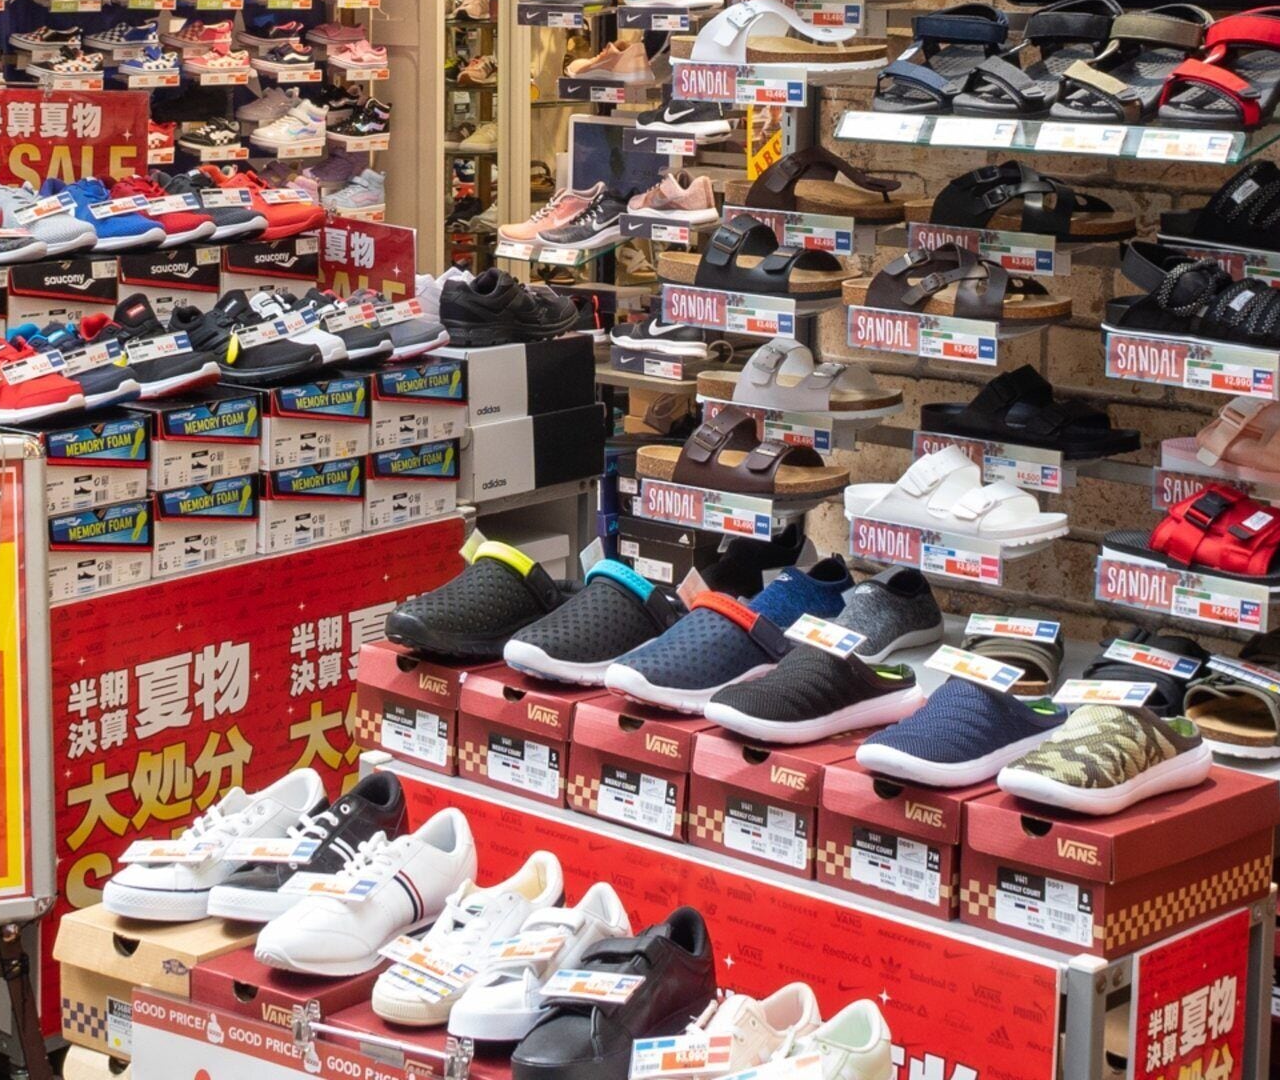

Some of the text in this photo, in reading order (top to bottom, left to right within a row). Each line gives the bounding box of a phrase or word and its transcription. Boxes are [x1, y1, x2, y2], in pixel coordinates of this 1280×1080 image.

[681, 68, 731, 97] SANDAL
[151, 261, 191, 275] saucony
[254, 252, 290, 265] saucony
[43, 273, 85, 288] saucony
[671, 292, 720, 323] SANDAL
[857, 315, 912, 348] SANDAL
[1117, 343, 1180, 378] SANDAL
[396, 373, 450, 393] MEMORY FOAM
[296, 390, 353, 410] MEMORY FOAM
[476, 404, 501, 416] adidas
[184, 413, 245, 435] MEMORY FOAM
[65, 433, 132, 458] MEMORY FOAM
[482, 478, 508, 490] adidas
[648, 488, 697, 520] SANDAL
[858, 524, 913, 560] SANDAL
[1107, 566, 1169, 606] SANDAL
[290, 614, 343, 659] 半期
[289, 652, 344, 698] 決算
[419, 672, 449, 696] VANS
[67, 670, 129, 718] 半期
[134, 640, 252, 740] 夏物
[527, 702, 560, 728] VANS
[67, 709, 129, 761] 決算
[644, 733, 680, 758] VANS
[65, 725, 254, 853] 大処分
[770, 764, 808, 790] VANS
[904, 800, 944, 828] VANS
[1056, 837, 1099, 866] VANS
[1000, 881, 1042, 898] WEEKLY COURT
[133, 999, 208, 1032] GOOD PRICE!
[1146, 1004, 1179, 1040] 半期
[1179, 976, 1238, 1053] 夏物
[228, 1026, 263, 1047] GOOD
[1146, 1037, 1178, 1072] 決算
